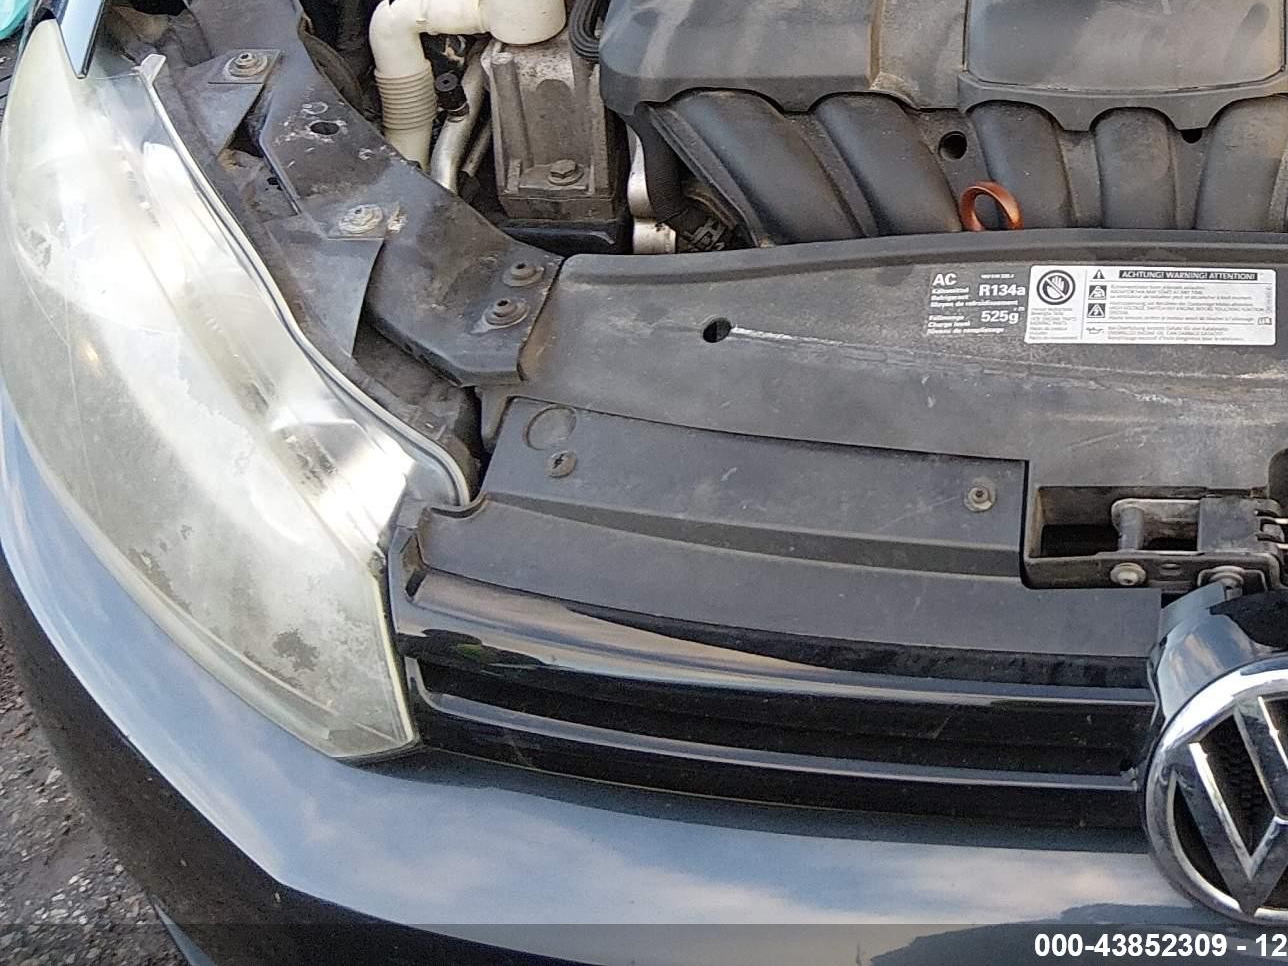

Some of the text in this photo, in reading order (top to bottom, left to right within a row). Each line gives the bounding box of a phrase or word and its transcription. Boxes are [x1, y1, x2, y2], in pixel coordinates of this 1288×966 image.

[932, 273, 957, 286] AC
[1121, 270, 1256, 280] ACHTUNG! WARNING! ATTENTION!
[978, 284, 1026, 296] R134a
[981, 310, 1019, 324] 525g
